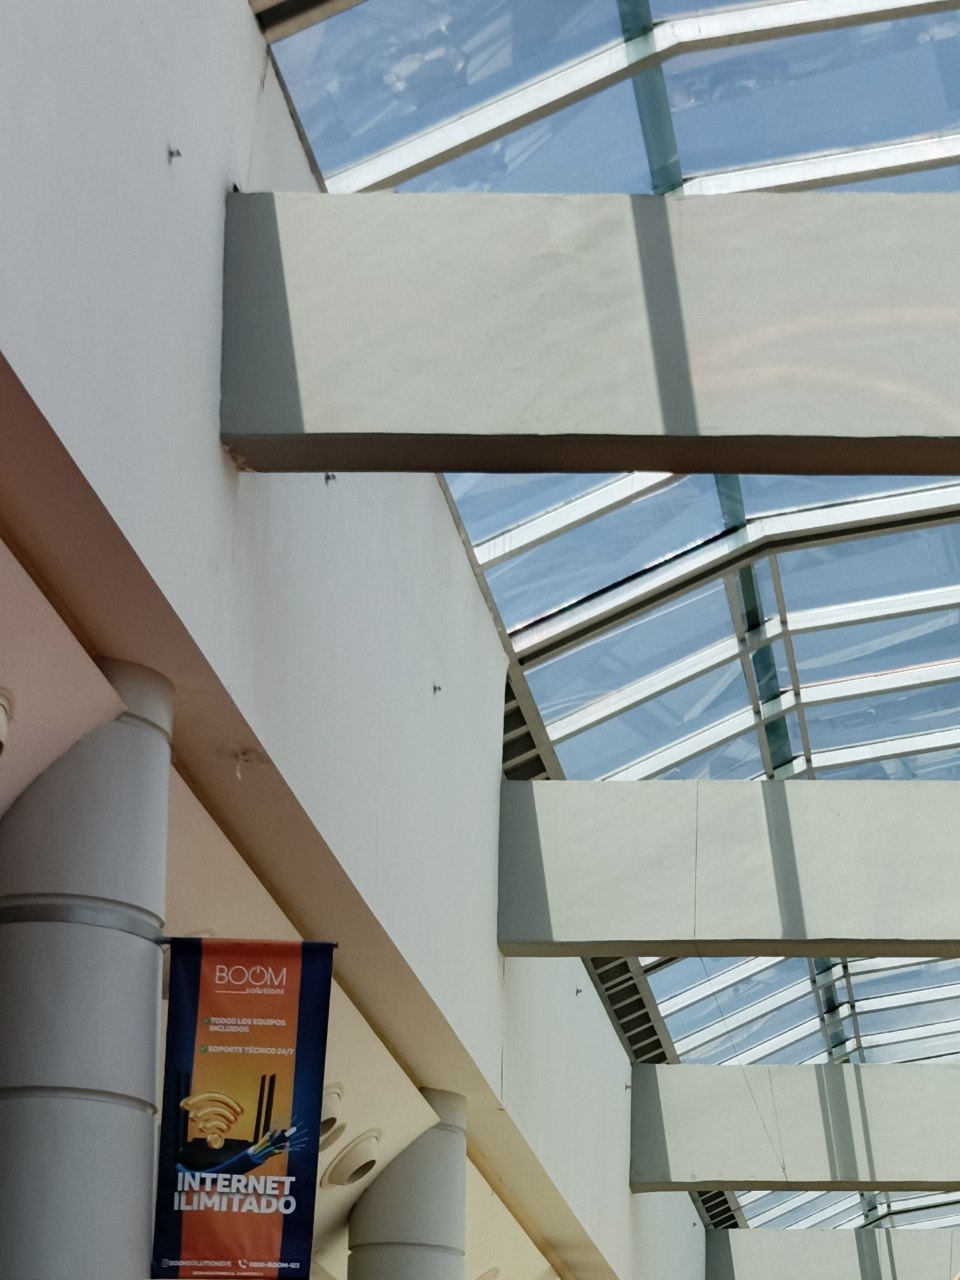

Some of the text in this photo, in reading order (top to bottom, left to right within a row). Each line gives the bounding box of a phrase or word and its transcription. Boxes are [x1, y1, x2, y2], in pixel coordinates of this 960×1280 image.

[215, 965, 287, 986] BOOM
[245, 987, 285, 995] solutions
[210, 1017, 236, 1025] TODOS
[177, 1172, 296, 1195] INTERNET
[173, 1192, 297, 1215] ILIMITADO
